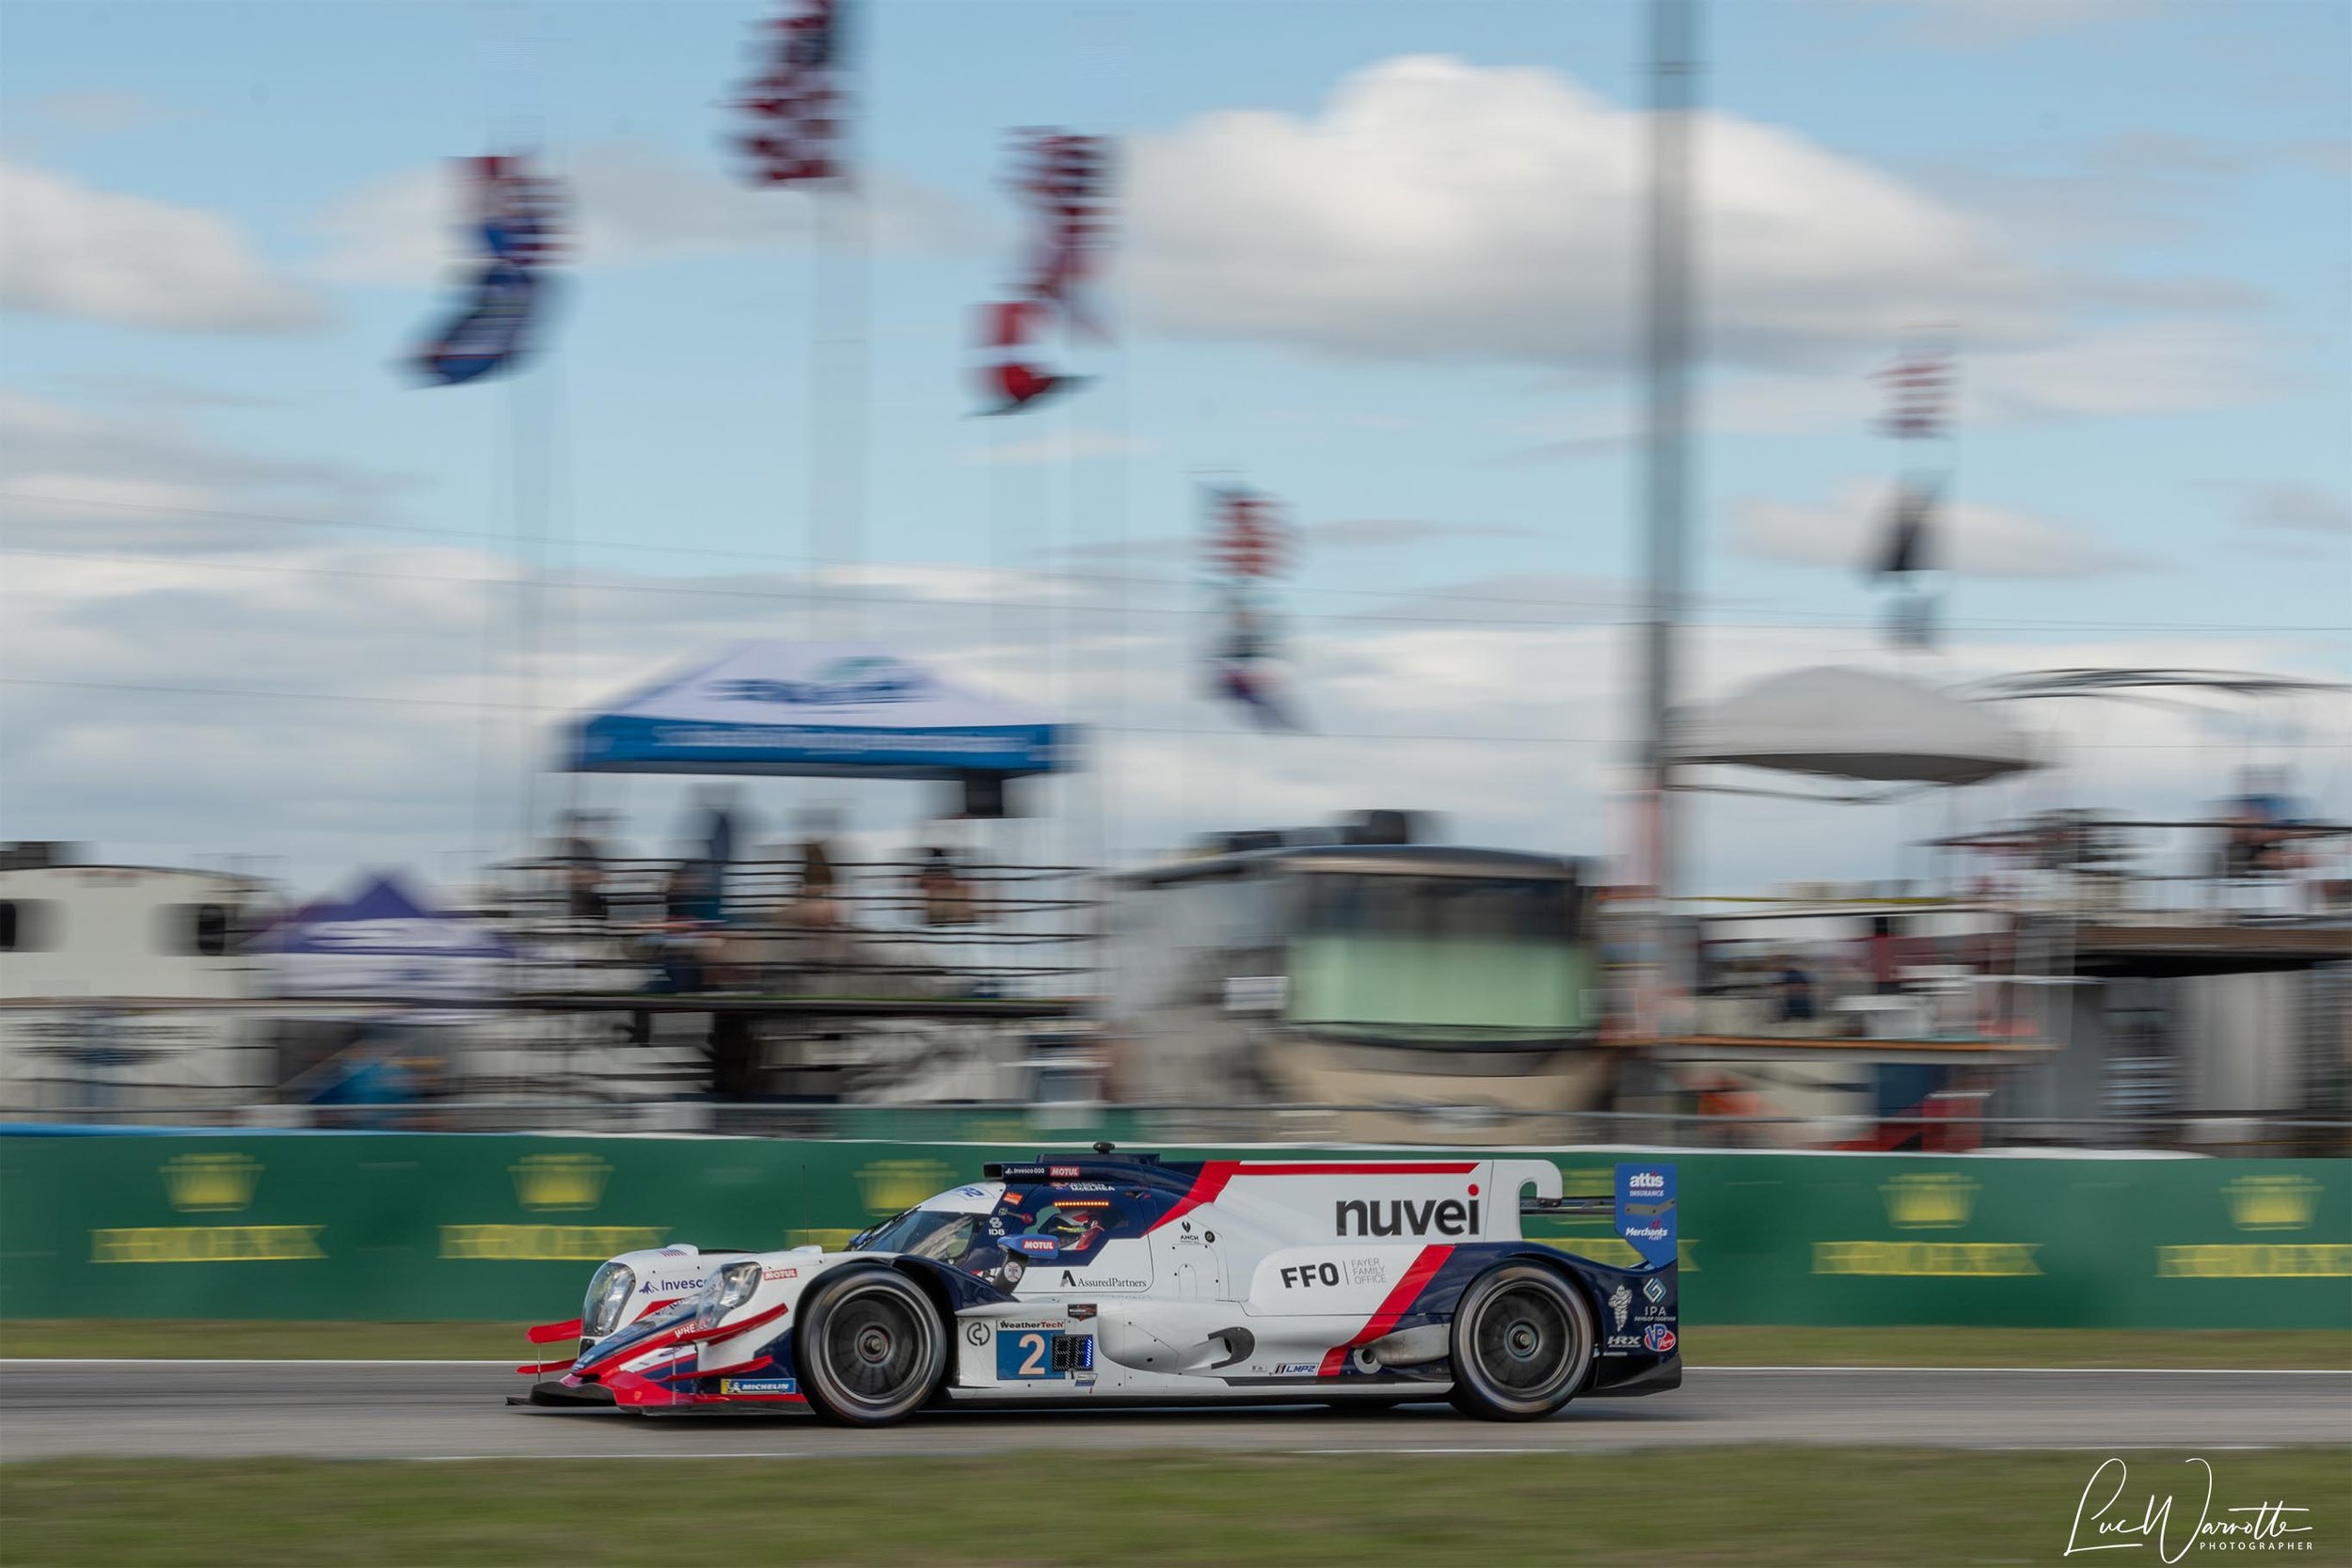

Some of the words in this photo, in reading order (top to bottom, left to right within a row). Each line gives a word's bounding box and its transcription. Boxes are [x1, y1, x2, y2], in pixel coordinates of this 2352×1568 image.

[1051, 1167, 1079, 1176] MOTUL
[1629, 1171, 1664, 1188] attis
[1336, 1183, 1480, 1237] nuvei
[1625, 1227, 1669, 1237] Merchants
[1024, 1241, 1055, 1250] MOTUL
[1351, 1258, 1380, 1268] FAYER
[765, 1270, 796, 1280] MOTUL
[1279, 1261, 1340, 1289] FFO
[1353, 1266, 1386, 1276] FAMILY
[1077, 1277, 1147, 1288] AssuredPartners
[1354, 1275, 1387, 1285] OFFICE
[660, 1279, 707, 1292] Invesc
[1645, 1306, 1667, 1316] IPA
[999, 1320, 1065, 1329] WeatherTech
[1018, 1333, 1045, 1375] 2
